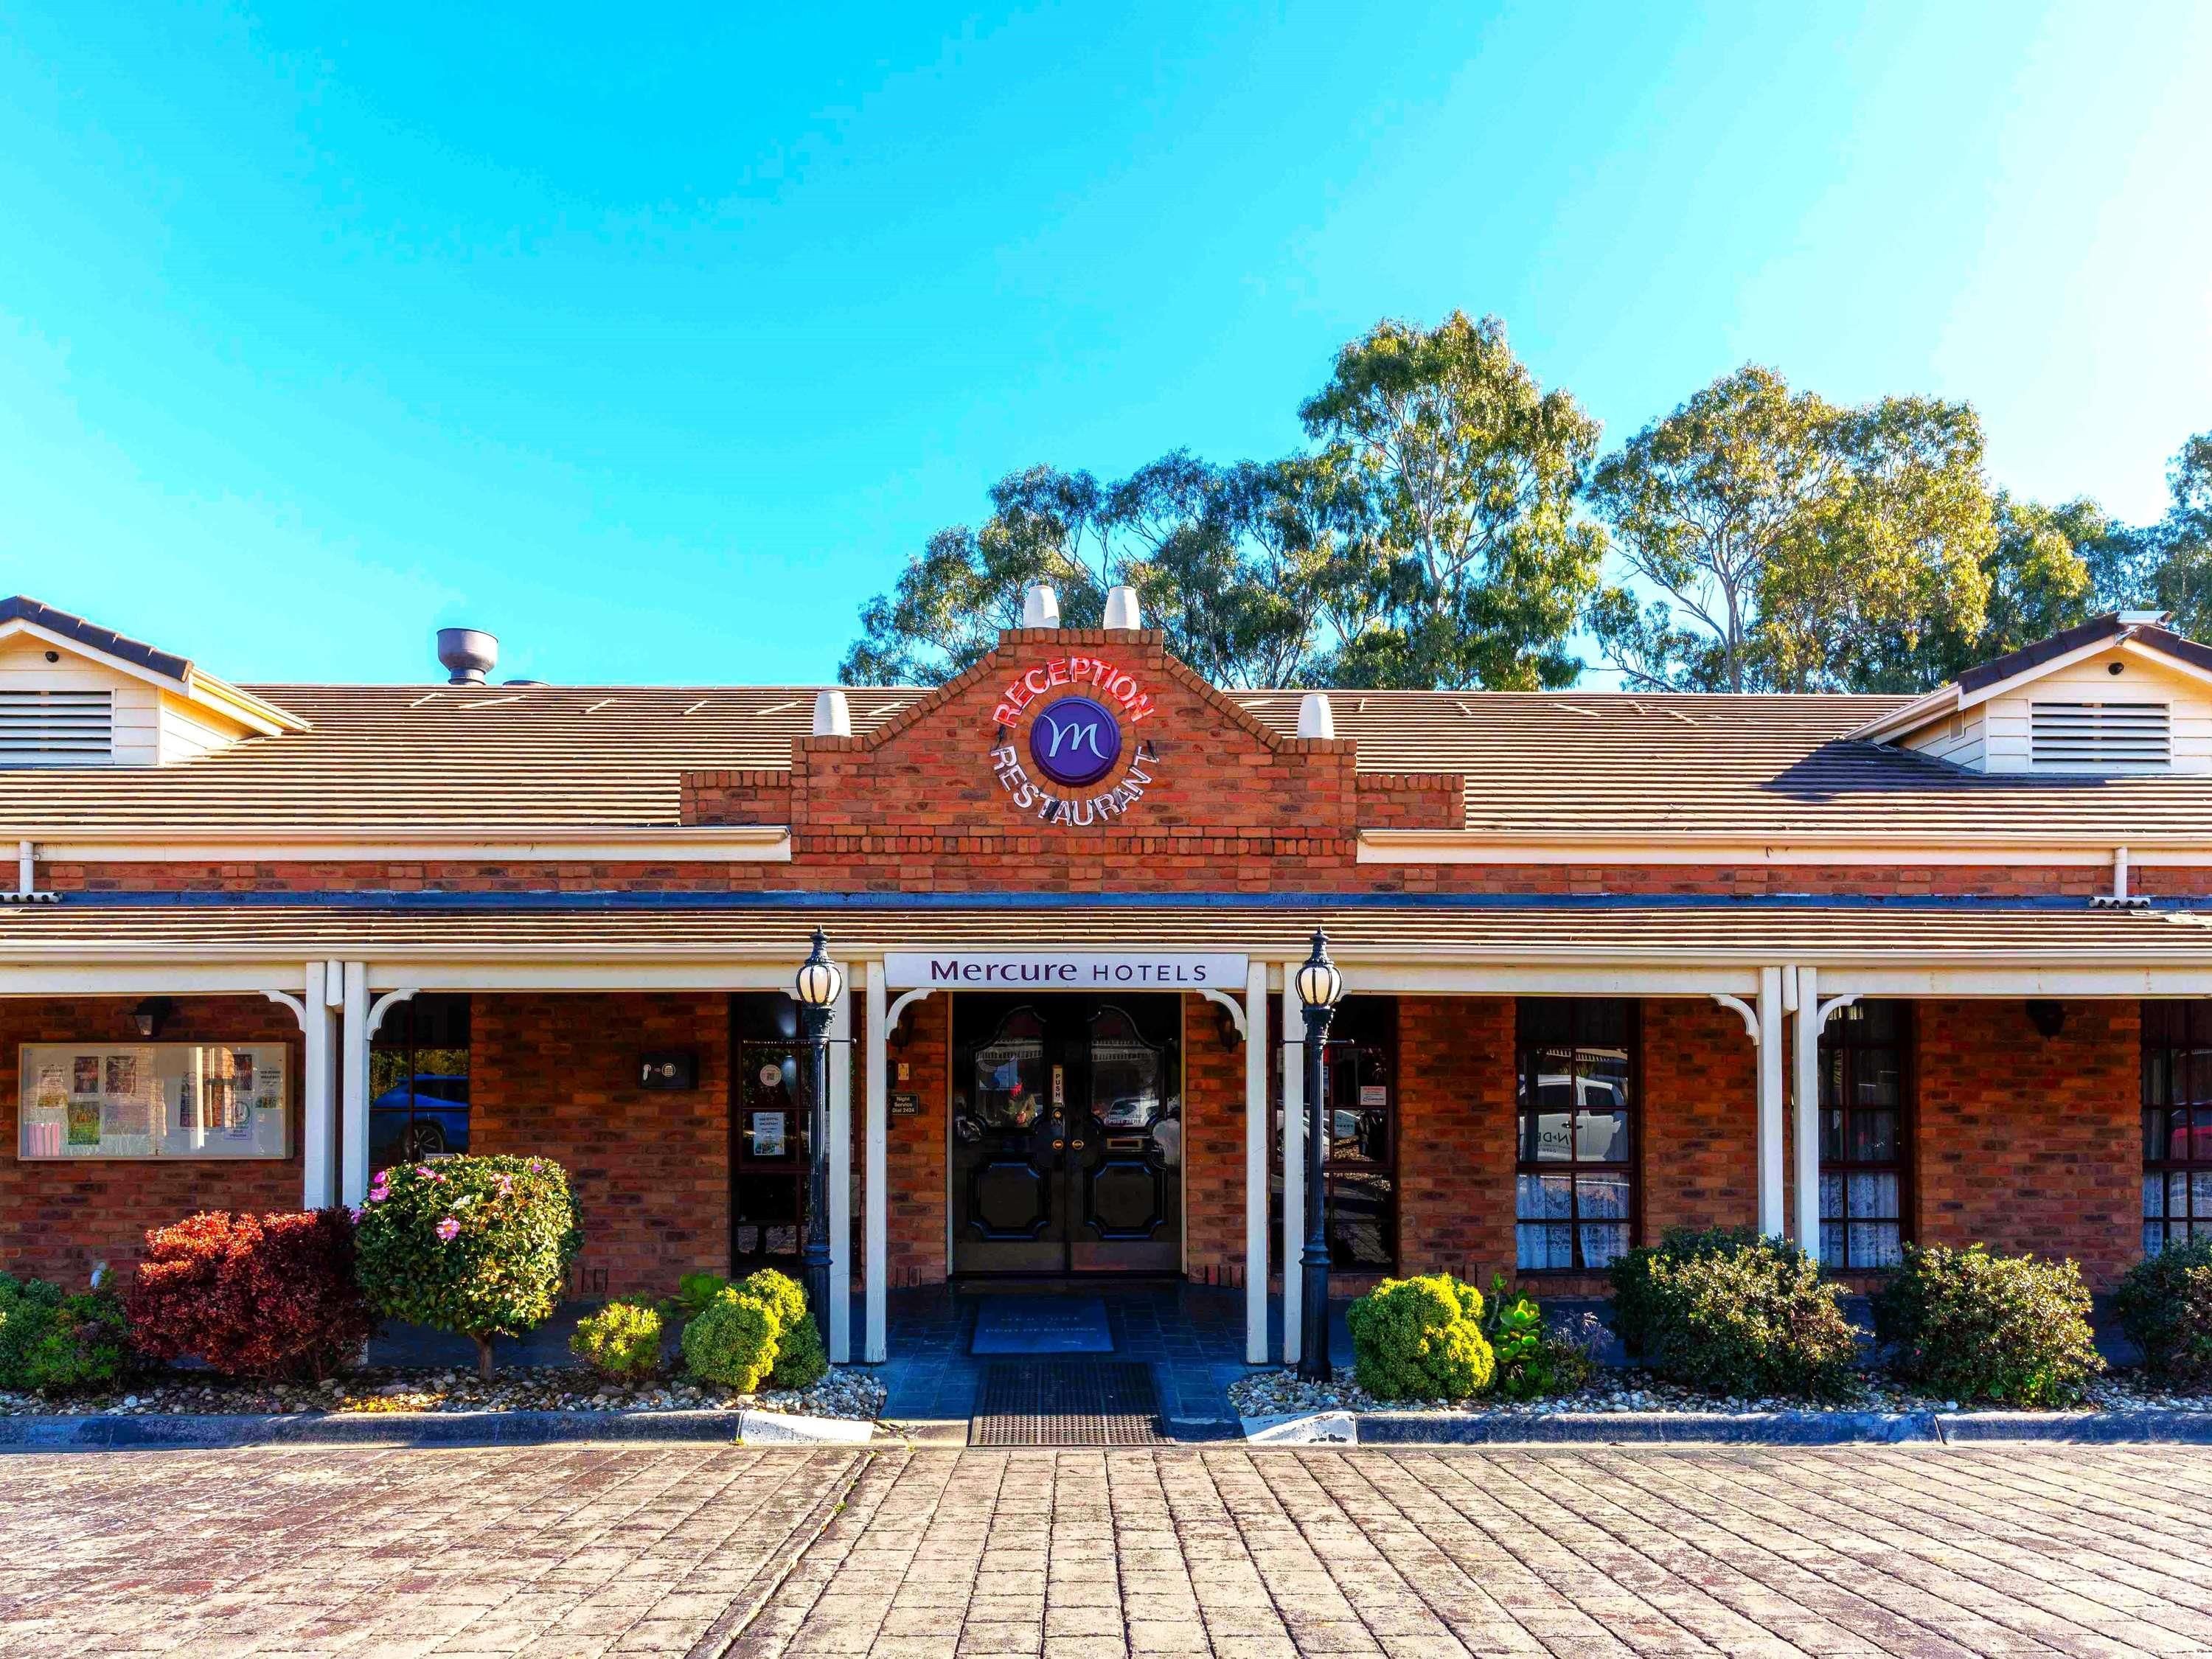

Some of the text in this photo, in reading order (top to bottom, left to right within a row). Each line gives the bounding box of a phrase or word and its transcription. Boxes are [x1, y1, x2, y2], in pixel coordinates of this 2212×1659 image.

[992, 655, 1155, 728] RECEPTION
[990, 745, 1159, 826] RESTAURANT
[931, 960, 1207, 981] Mercure HOTELS
